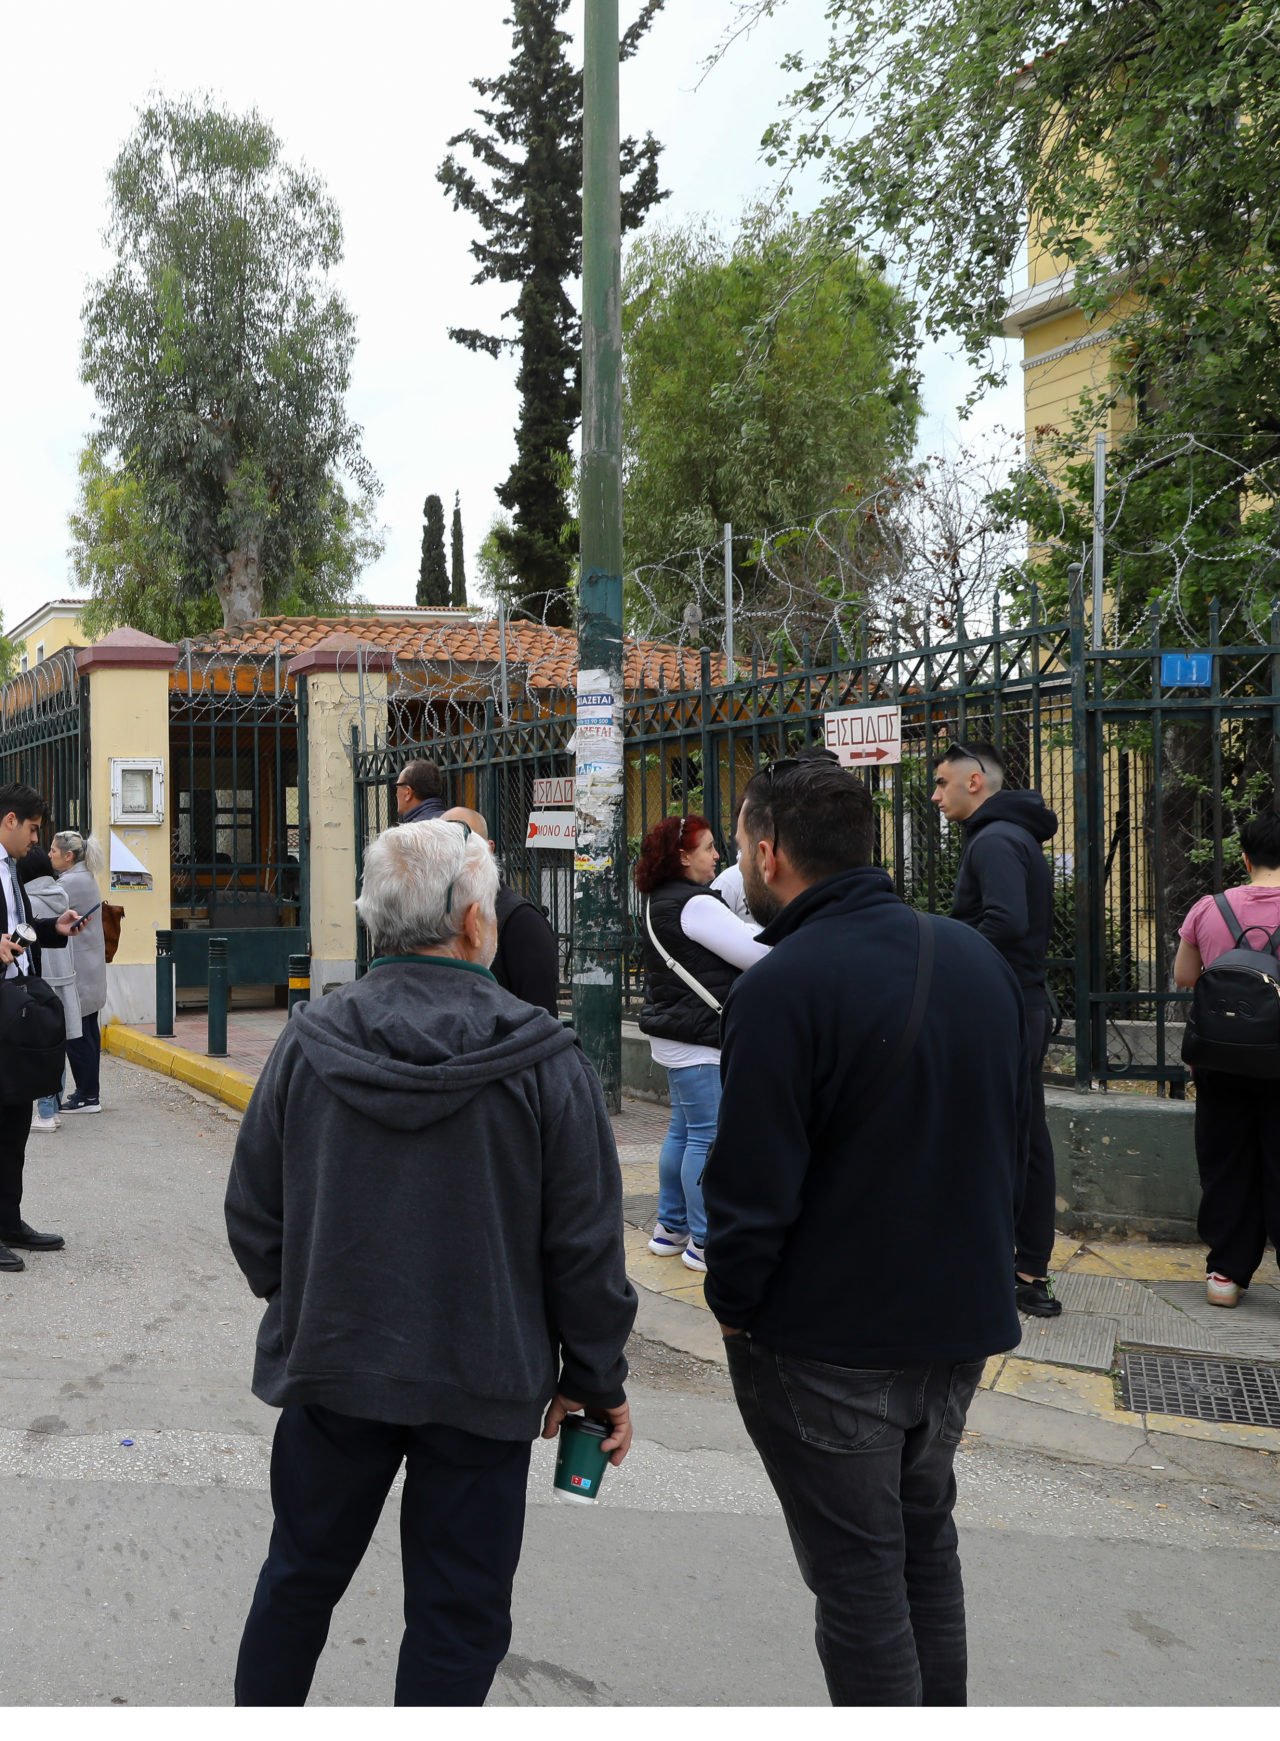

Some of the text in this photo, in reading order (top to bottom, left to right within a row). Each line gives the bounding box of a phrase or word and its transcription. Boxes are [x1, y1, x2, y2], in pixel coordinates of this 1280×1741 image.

[1177, 660, 1197, 681] 11
[826, 713, 898, 746] ΕΙΣΟΔΟΣ
[532, 779, 575, 804] ΕΙΣΟΔΟ
